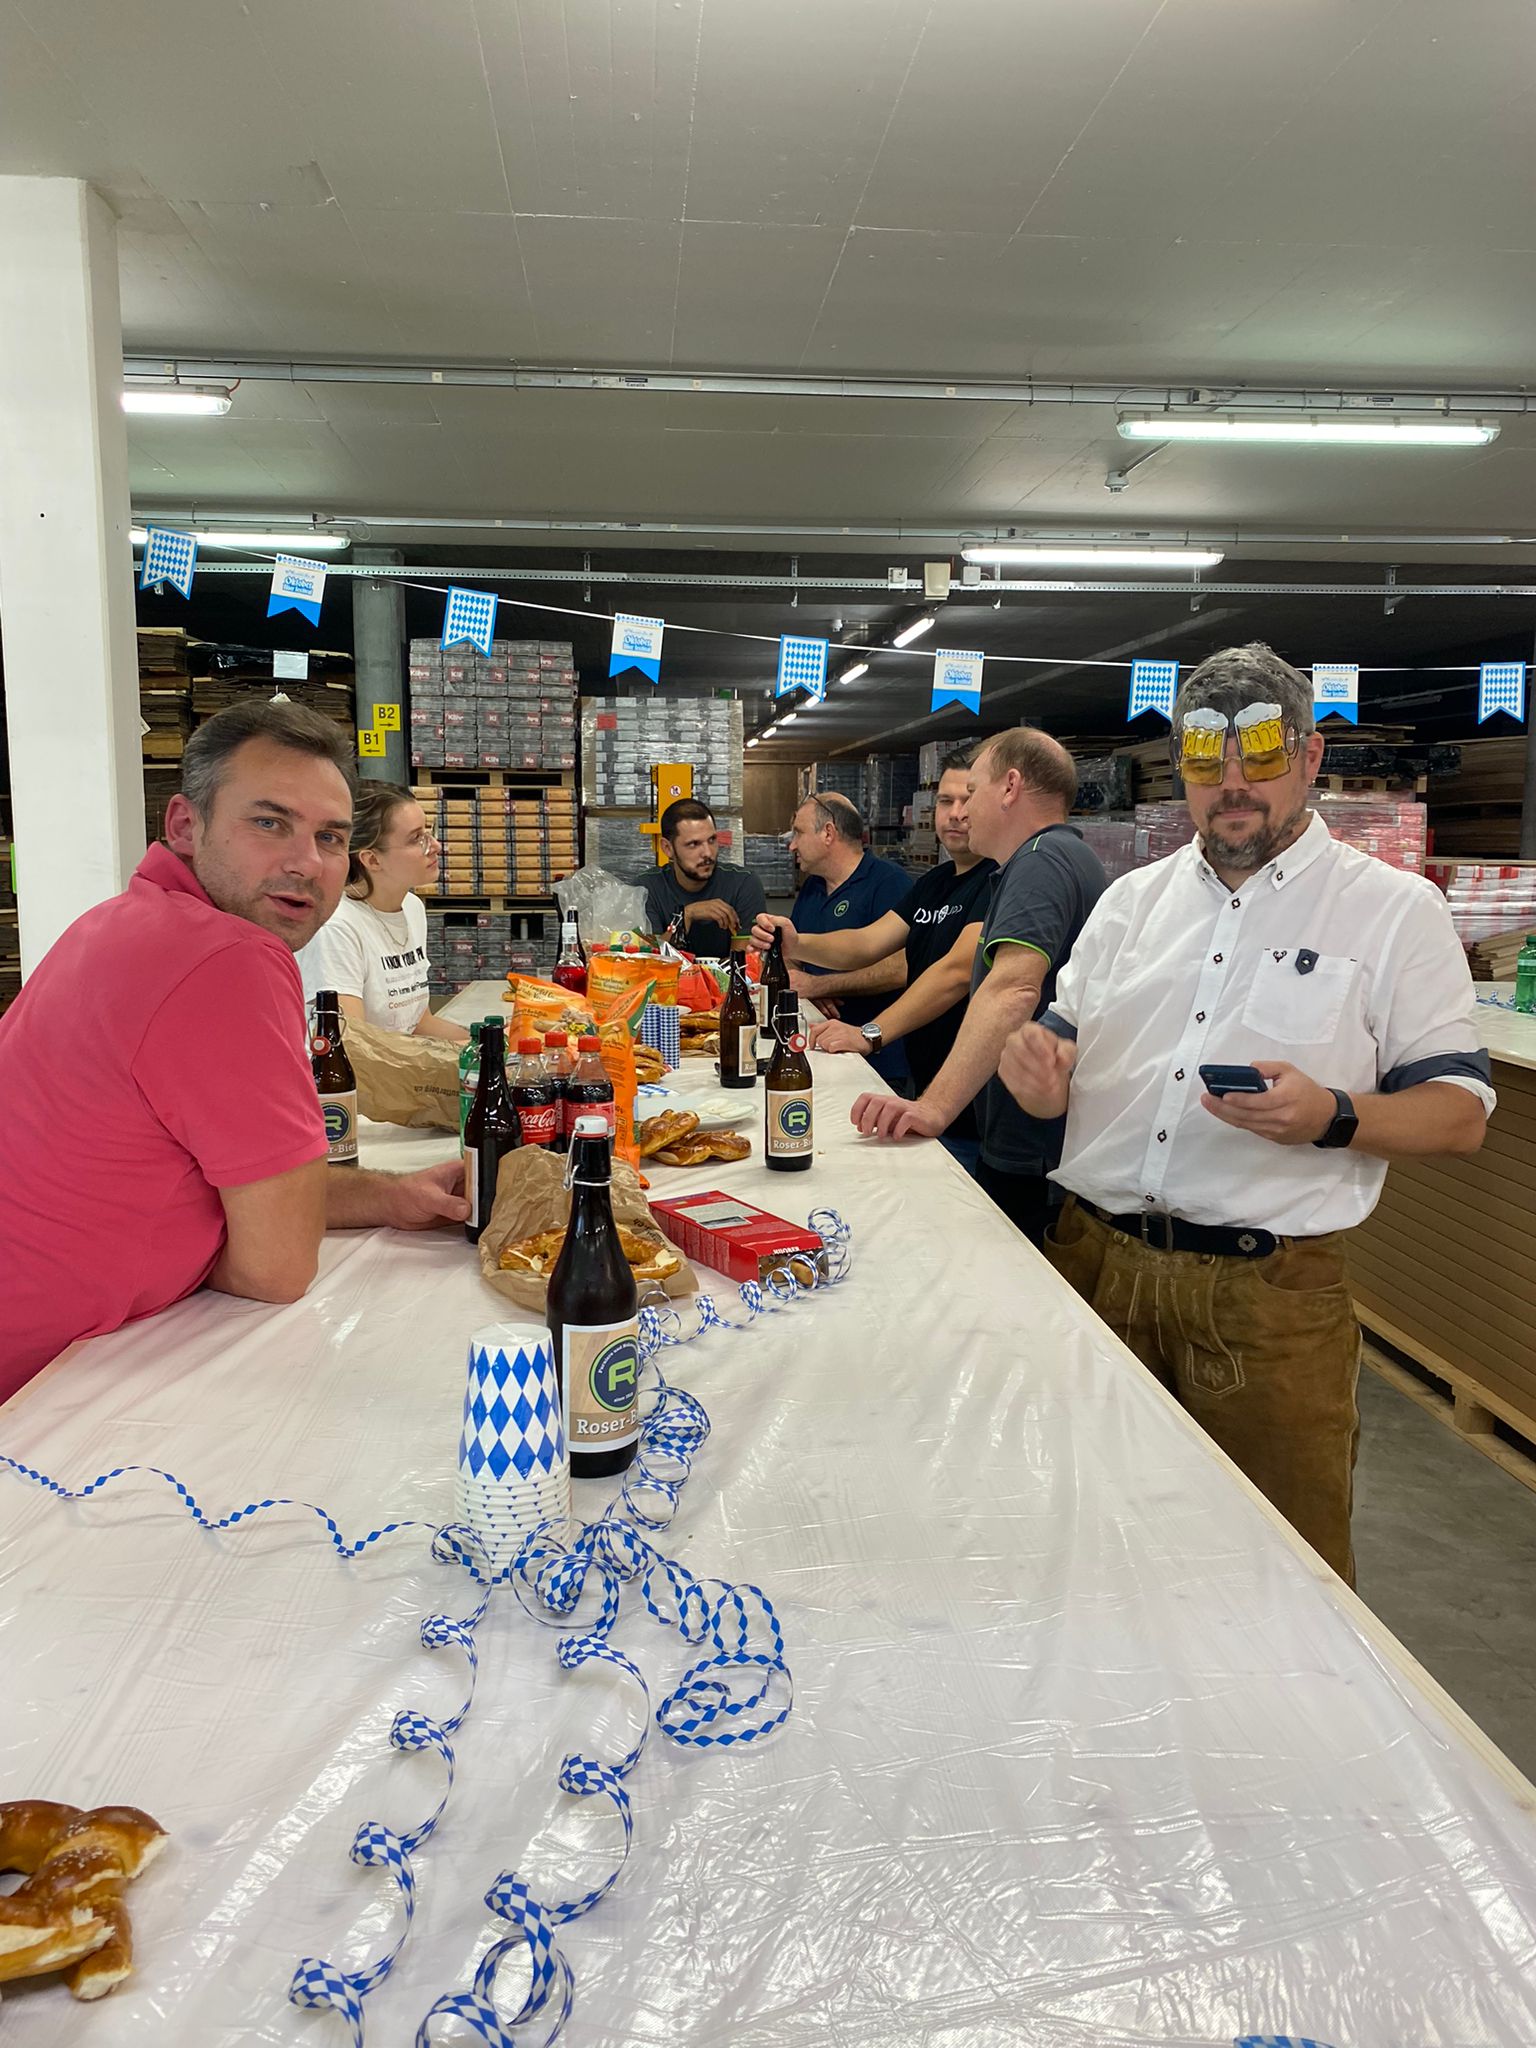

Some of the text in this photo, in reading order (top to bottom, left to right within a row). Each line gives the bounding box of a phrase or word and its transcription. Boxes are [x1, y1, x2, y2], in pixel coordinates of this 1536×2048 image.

[379, 706, 395, 719] B2
[364, 733, 379, 745] B1
[328, 1143, 356, 1154] r-Bier
[608, 1357, 636, 1392] R
[576, 1408, 637, 1435] Roser-B
